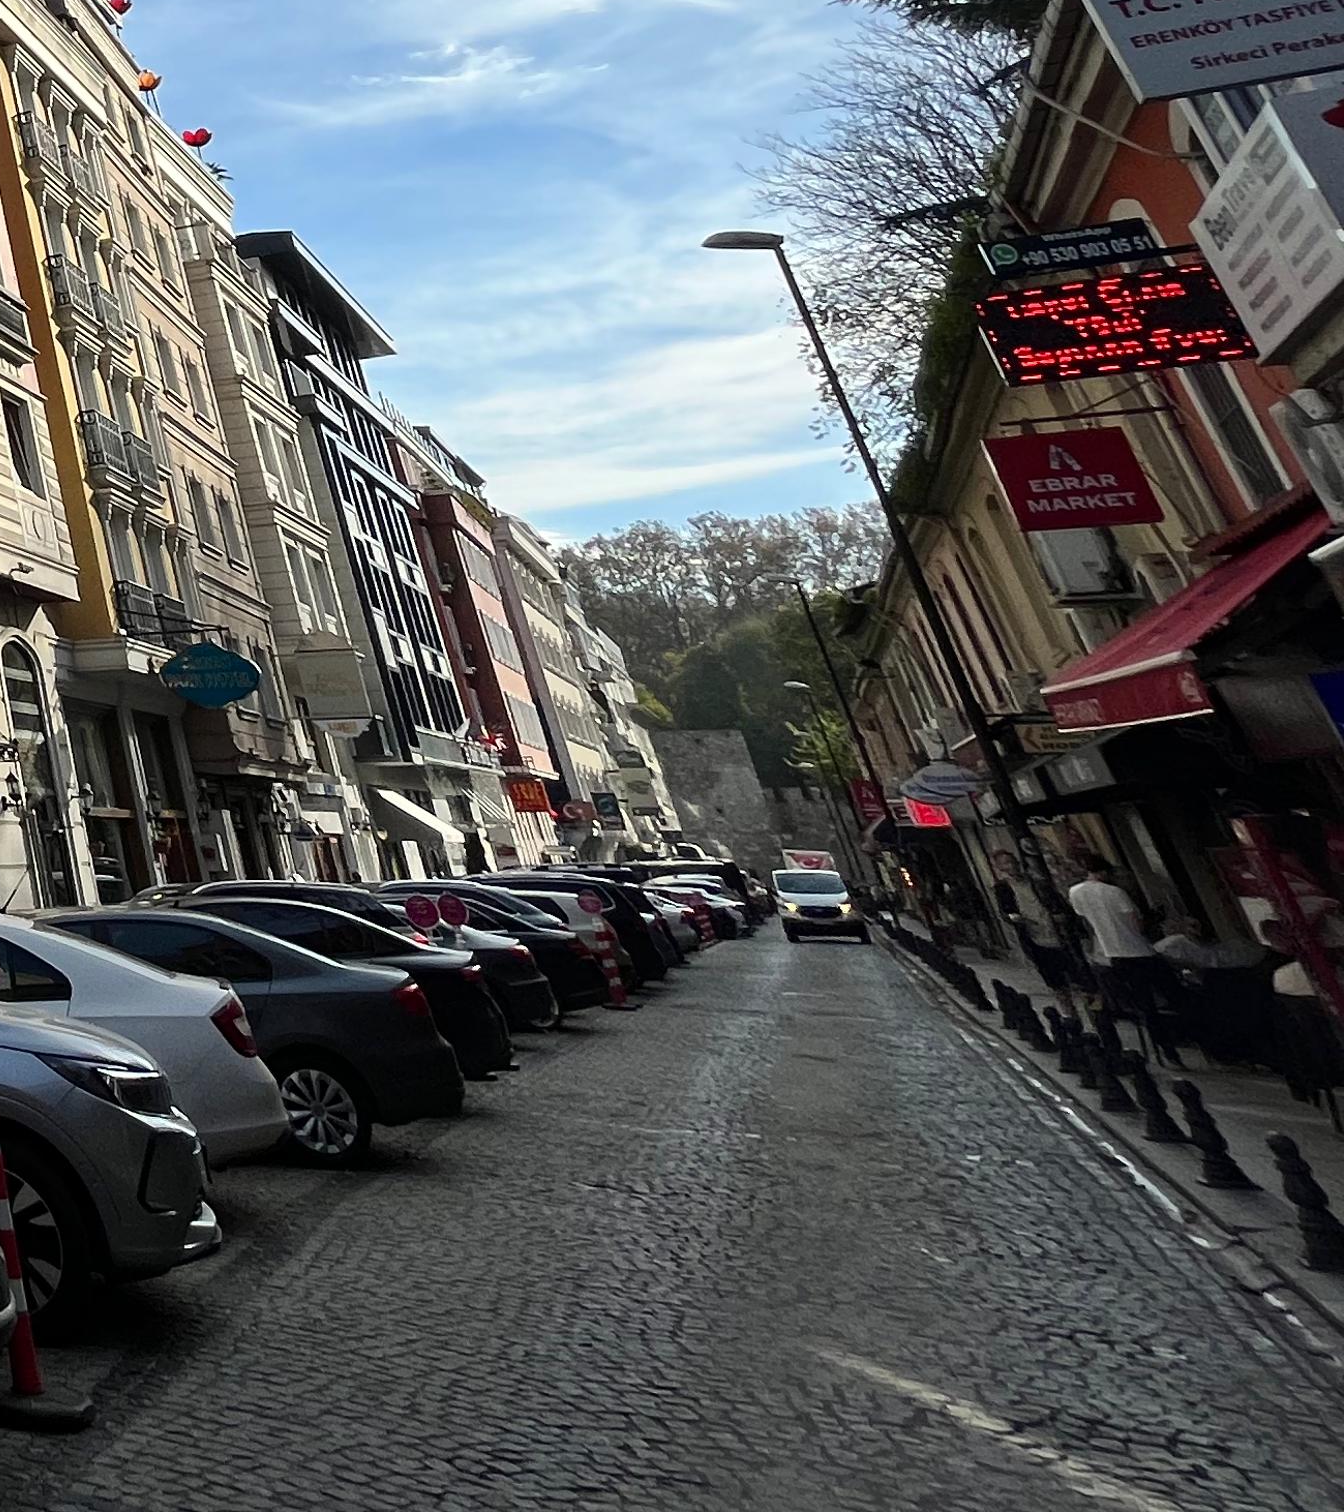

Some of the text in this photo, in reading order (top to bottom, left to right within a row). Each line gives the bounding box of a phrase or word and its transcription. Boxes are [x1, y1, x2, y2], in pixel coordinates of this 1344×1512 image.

[1129, 17, 1234, 49] ERENKÖY
[1190, 43, 1268, 71] Sirkeci
[1028, 472, 1118, 492] EBRAR
[1026, 491, 1137, 514] MARKET
